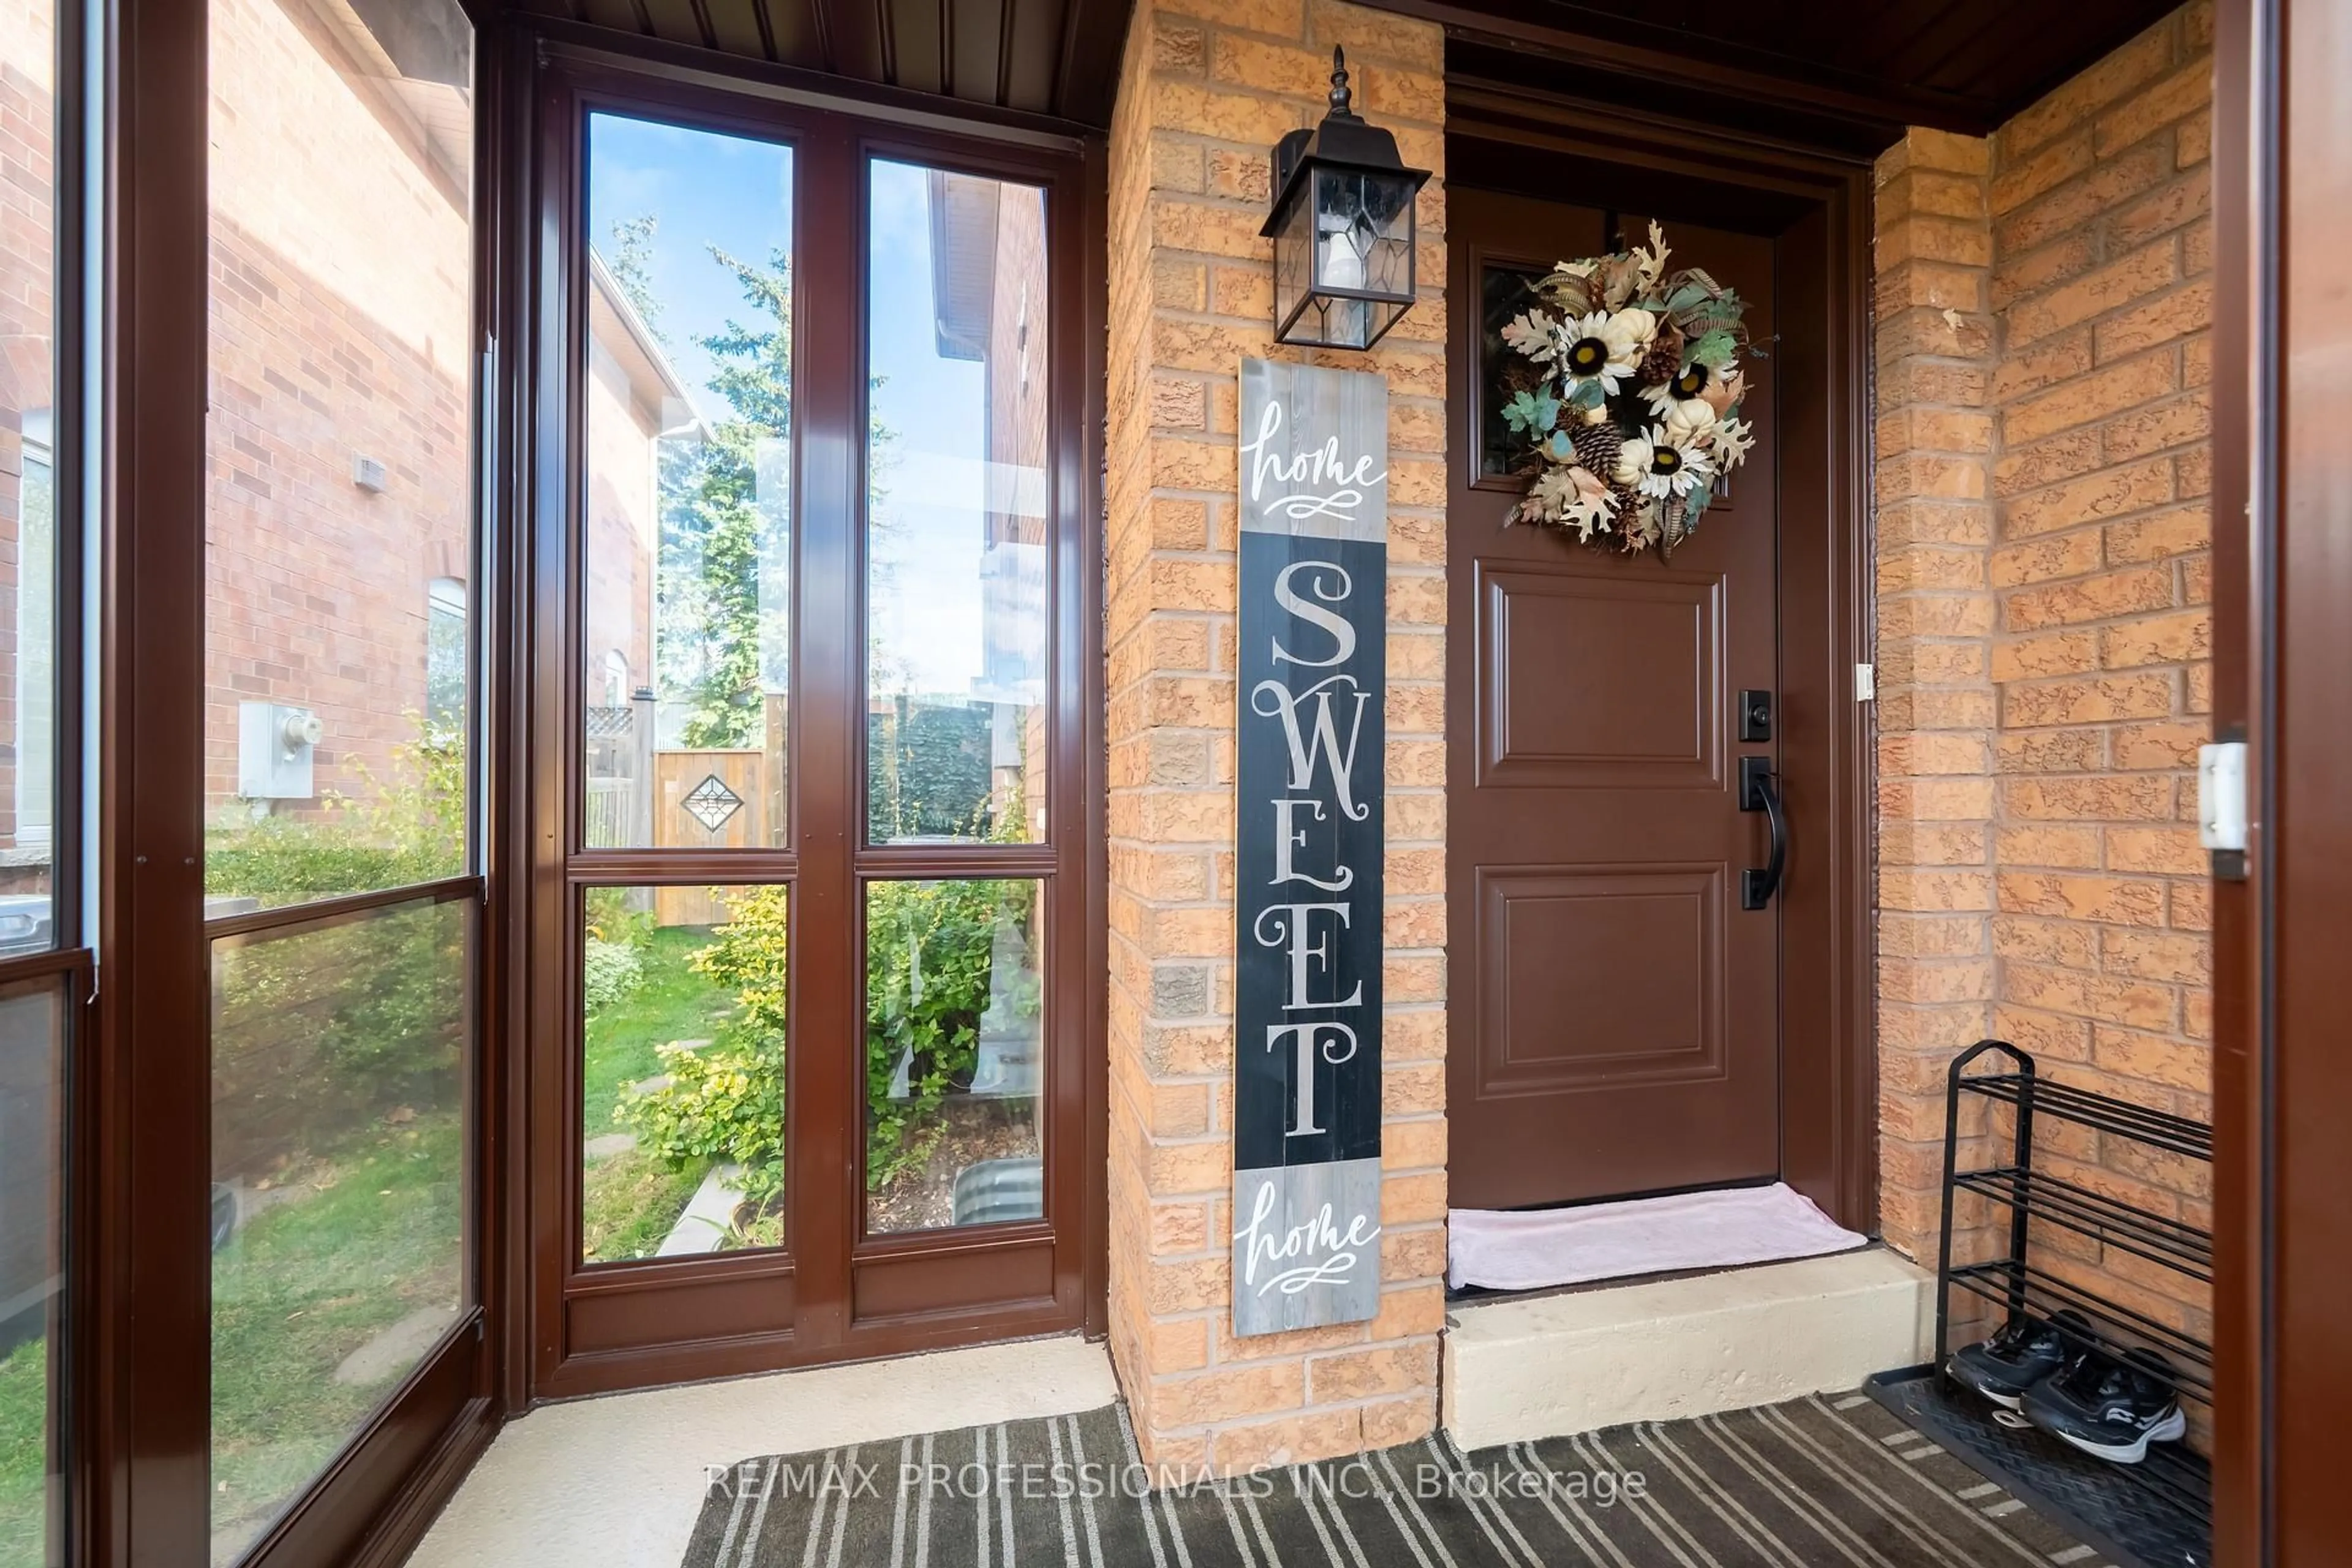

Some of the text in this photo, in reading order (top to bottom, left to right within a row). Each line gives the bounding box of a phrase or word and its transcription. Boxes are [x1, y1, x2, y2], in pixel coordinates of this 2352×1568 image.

[1240, 401, 1387, 501] home
[1251, 560, 1371, 1137] SWEET
[1234, 1181, 1381, 1285] home
